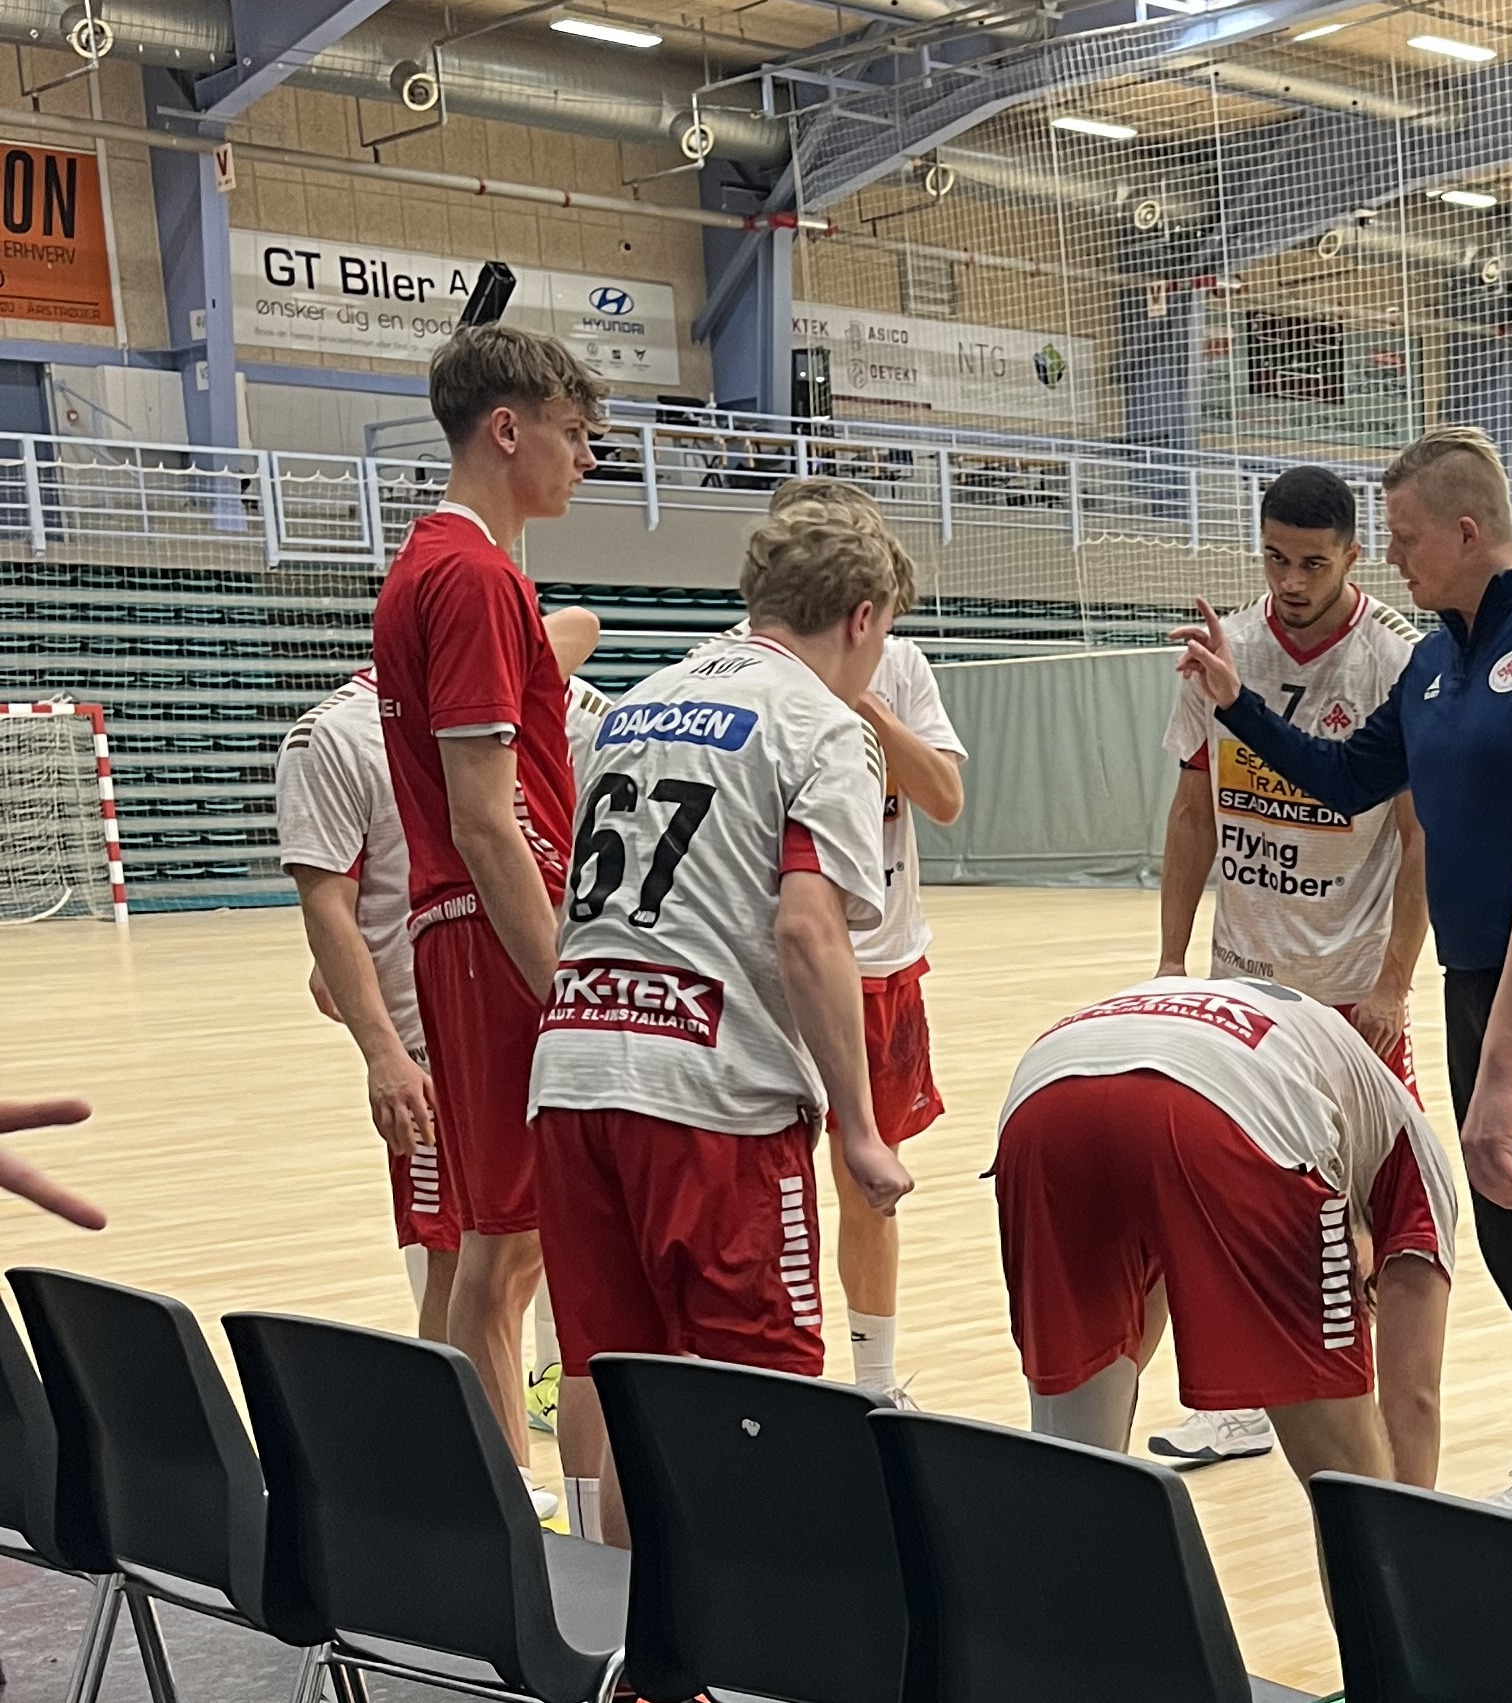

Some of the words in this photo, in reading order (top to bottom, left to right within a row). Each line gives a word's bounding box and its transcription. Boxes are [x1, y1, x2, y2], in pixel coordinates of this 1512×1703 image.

[4, 239, 76, 265] ERHVERV
[264, 247, 321, 290] GT
[339, 256, 435, 303] Biler
[255, 299, 327, 321] ønsker
[336, 305, 370, 332] dig
[378, 313, 404, 331] en
[412, 316, 453, 339] god
[582, 317, 645, 335] HYUNDAI
[868, 326, 909, 344] ASICO
[958, 341, 1006, 378] NTG
[570, 772, 717, 928] 67
[1222, 824, 1298, 869] Flying
